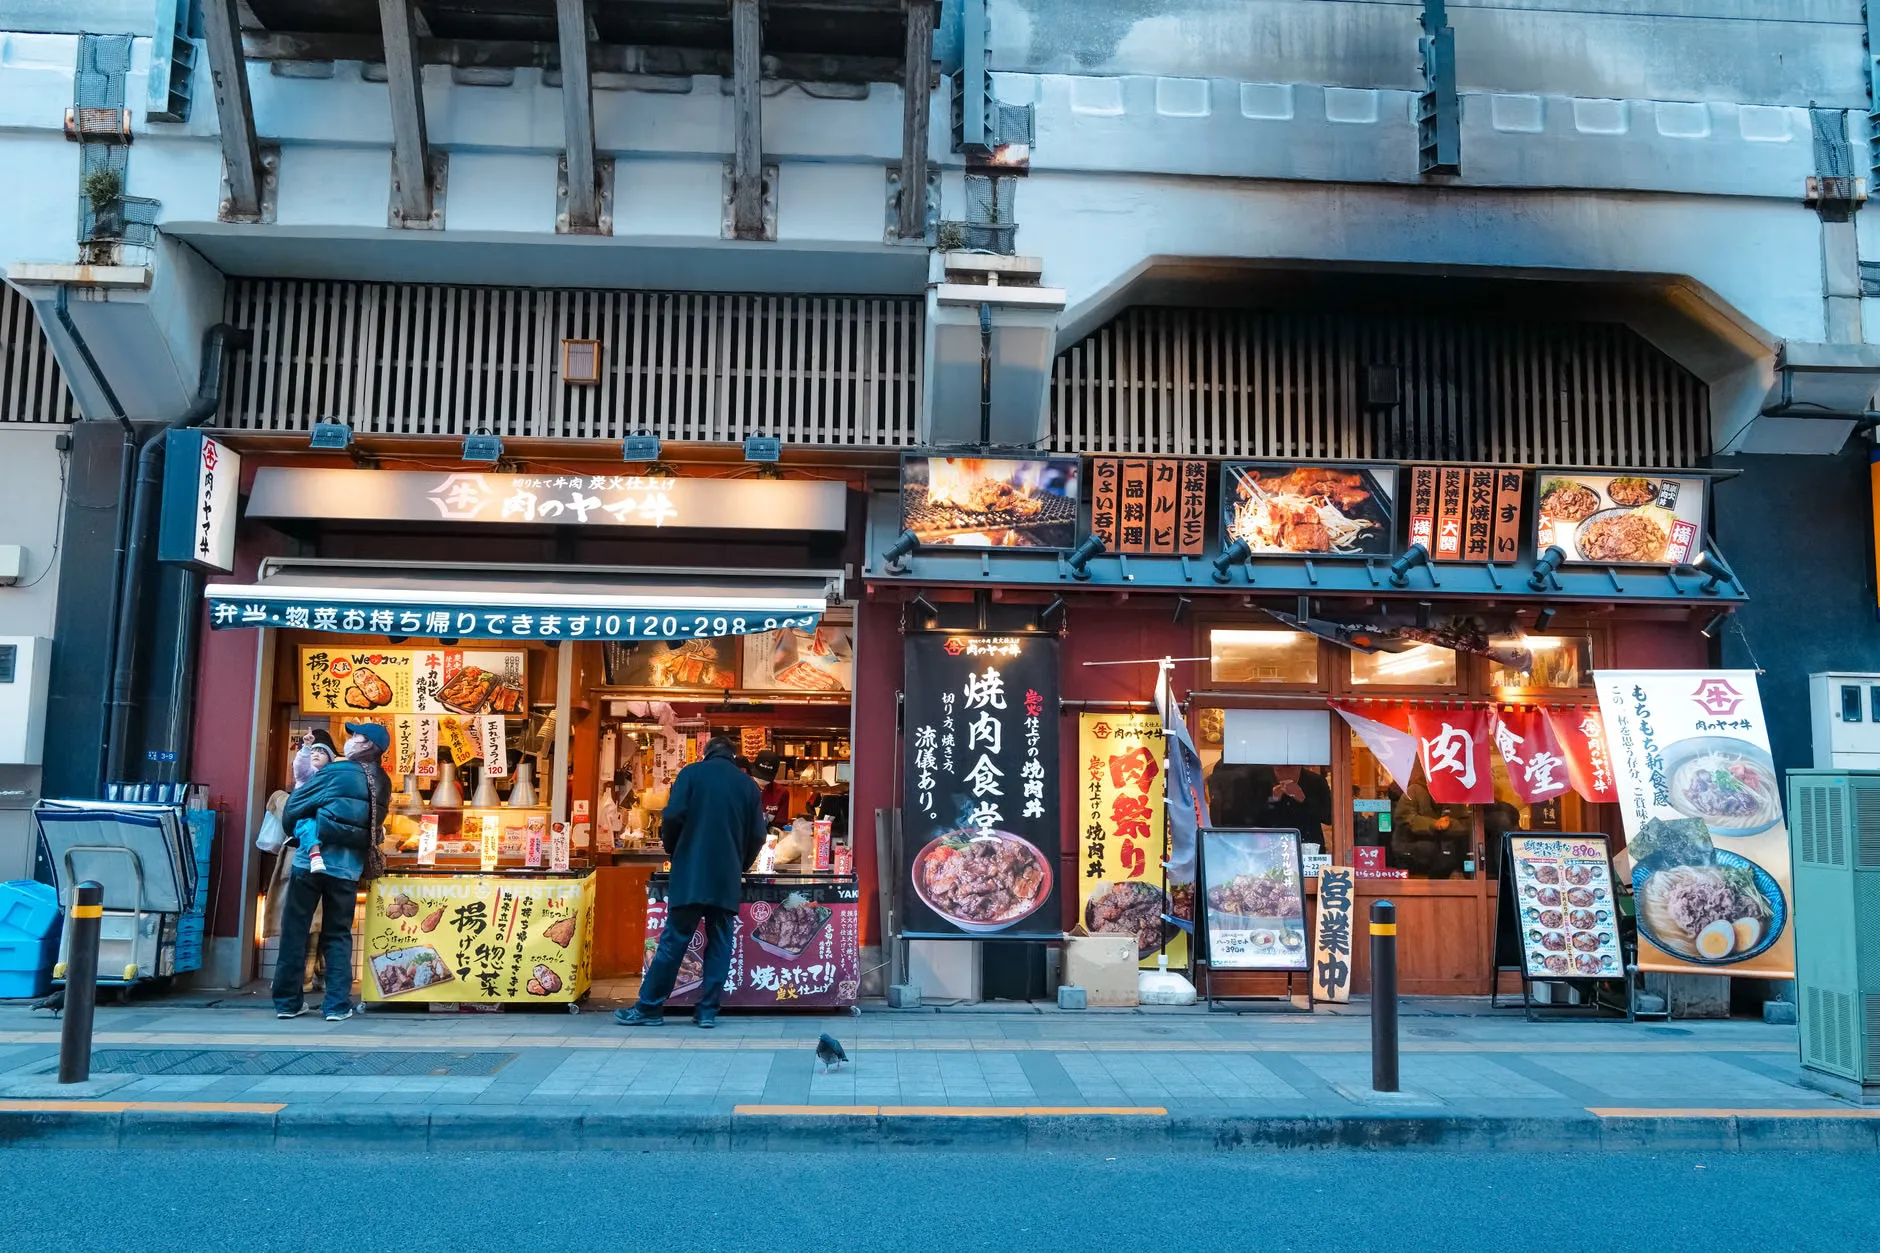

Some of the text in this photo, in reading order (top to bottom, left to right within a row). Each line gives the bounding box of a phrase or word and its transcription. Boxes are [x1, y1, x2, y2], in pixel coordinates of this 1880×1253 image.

[200, 470, 214, 558] 肉のヤマ牛
[501, 492, 679, 528] 肉のヤマ牛
[1094, 461, 1115, 545] ちょい呑み
[1123, 462, 1146, 545] 一品料理
[1153, 463, 1174, 546] カルビ
[1183, 462, 1205, 547] 鉄板ホルモン
[1415, 469, 1432, 515] 炭火焼肉丼
[1443, 470, 1460, 516] 炭火焼肉丼
[1468, 471, 1491, 554] 炭火焼肉丼
[1497, 471, 1520, 553] 肉すい
[306, 652, 330, 699] 揚げたて
[966, 643, 1022, 657] 肉のヤマ牛
[420, 719, 430, 759] メンチカツ
[941, 692, 956, 775] 切り方、焼き方、
[963, 665, 1009, 844] 焼肉食堂
[1019, 688, 1046, 819] 炭火仕上げの焼肉丼
[1114, 727, 1166, 741] 肉のヤマ牛
[1421, 722, 1477, 790] 肉
[1630, 684, 1672, 808] もちもち新食感
[1695, 719, 1753, 731] 肉のヤマ牛
[418, 766, 435, 774] 250
[488, 766, 503, 774] 120
[914, 725, 938, 820] 流儀あり。
[1085, 755, 1106, 879] 炭火仕上げの焼肉丼
[1108, 746, 1160, 879] 肉祭り
[1360, 849, 1379, 858] 入口
[376, 884, 472, 899] YAKINIKU
[449, 900, 487, 983] 揚げたて
[474, 942, 506, 998] 惣菜
[507, 896, 534, 998] お持ち帰りできます
[1317, 869, 1353, 999] 営業中
